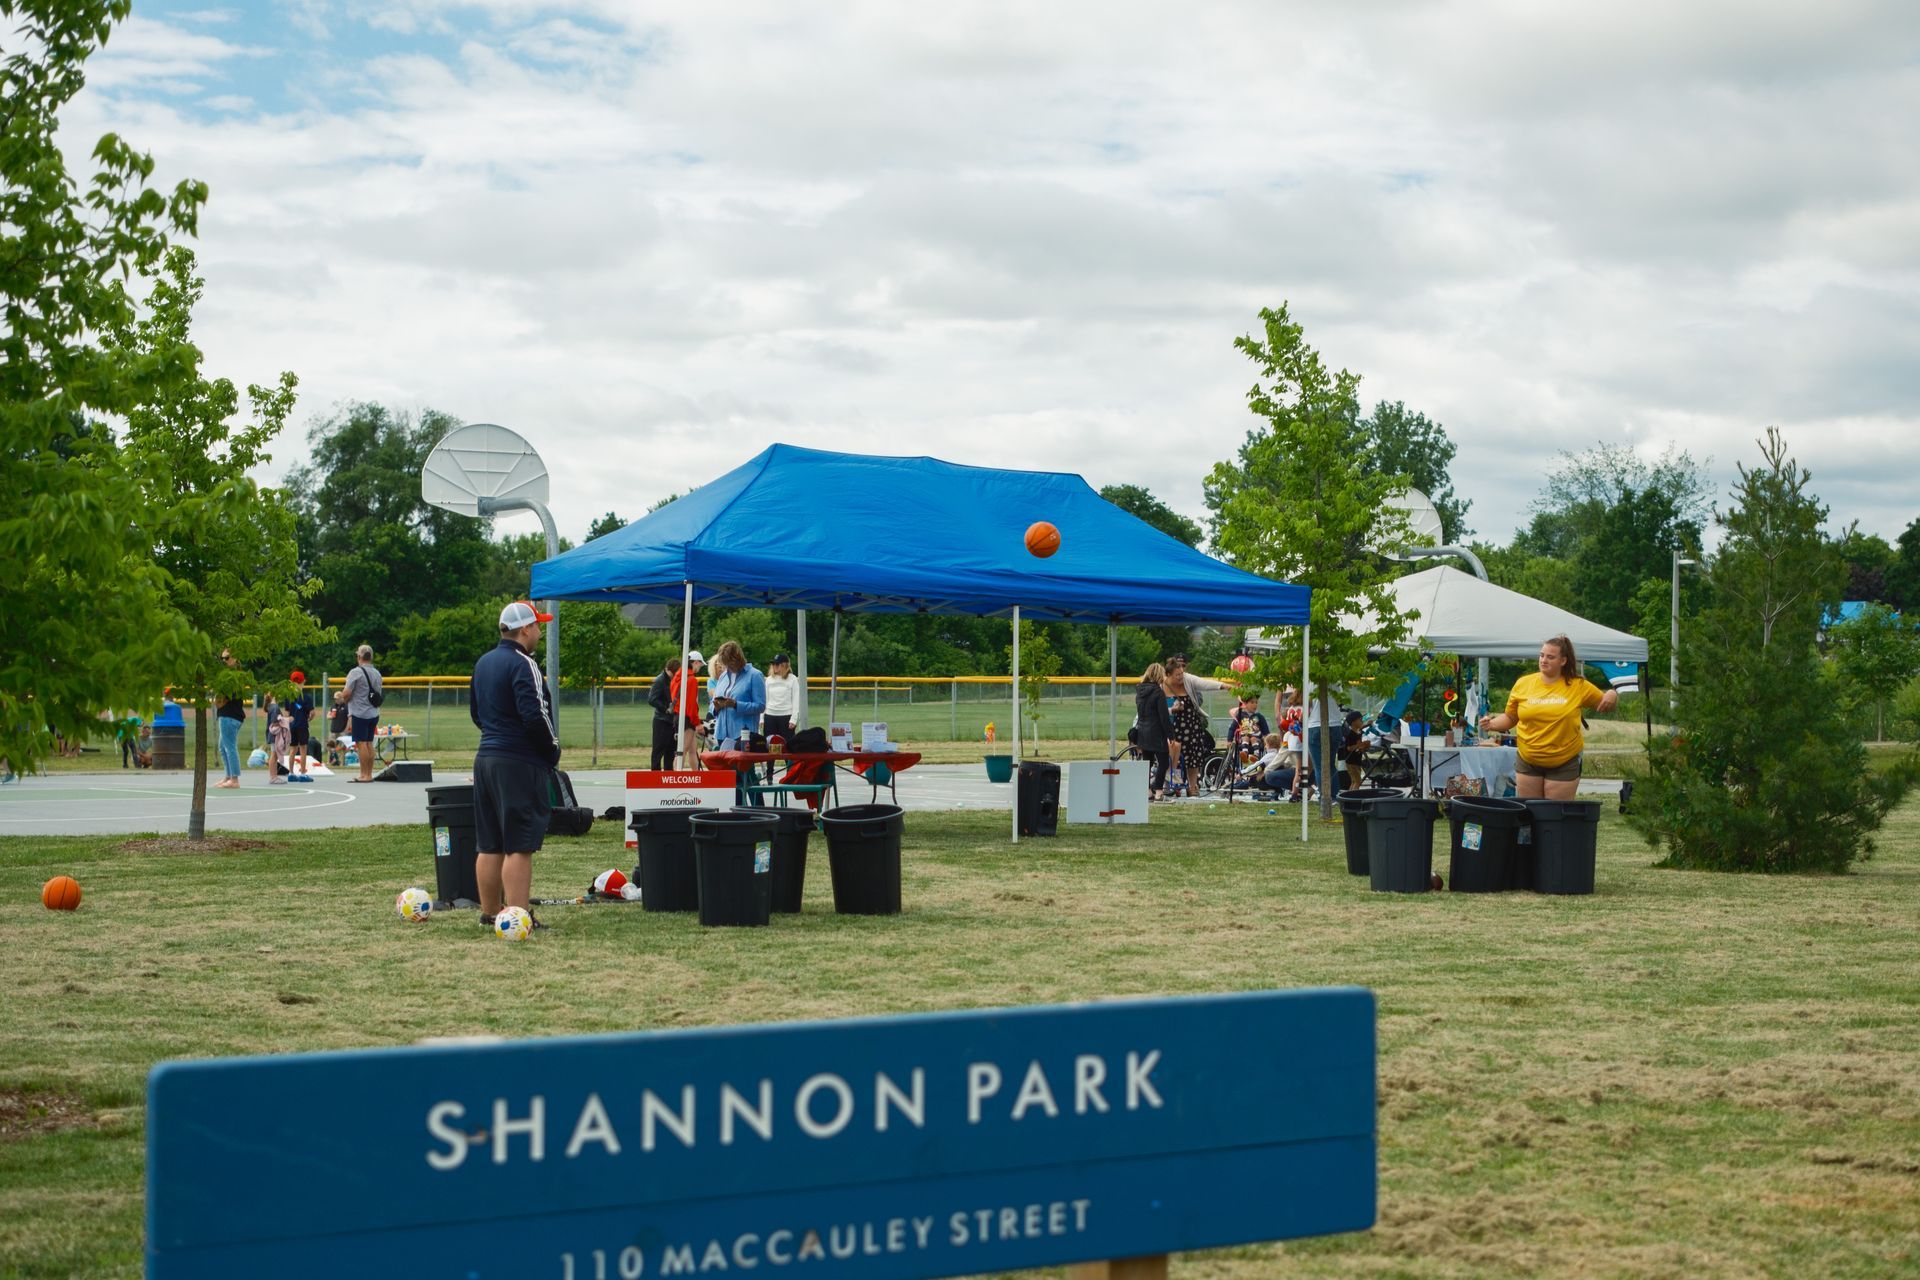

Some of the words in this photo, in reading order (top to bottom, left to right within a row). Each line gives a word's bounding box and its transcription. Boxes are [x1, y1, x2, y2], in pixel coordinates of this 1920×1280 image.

[660, 798, 698, 806] motionball
[661, 776, 702, 784] WELCOME!
[426, 1068, 925, 1170] SHANNON
[967, 1050, 1164, 1123] PARK
[562, 1246, 644, 1280] 110
[660, 1216, 933, 1275] MACCAULEY
[949, 1199, 1091, 1246] STREET
